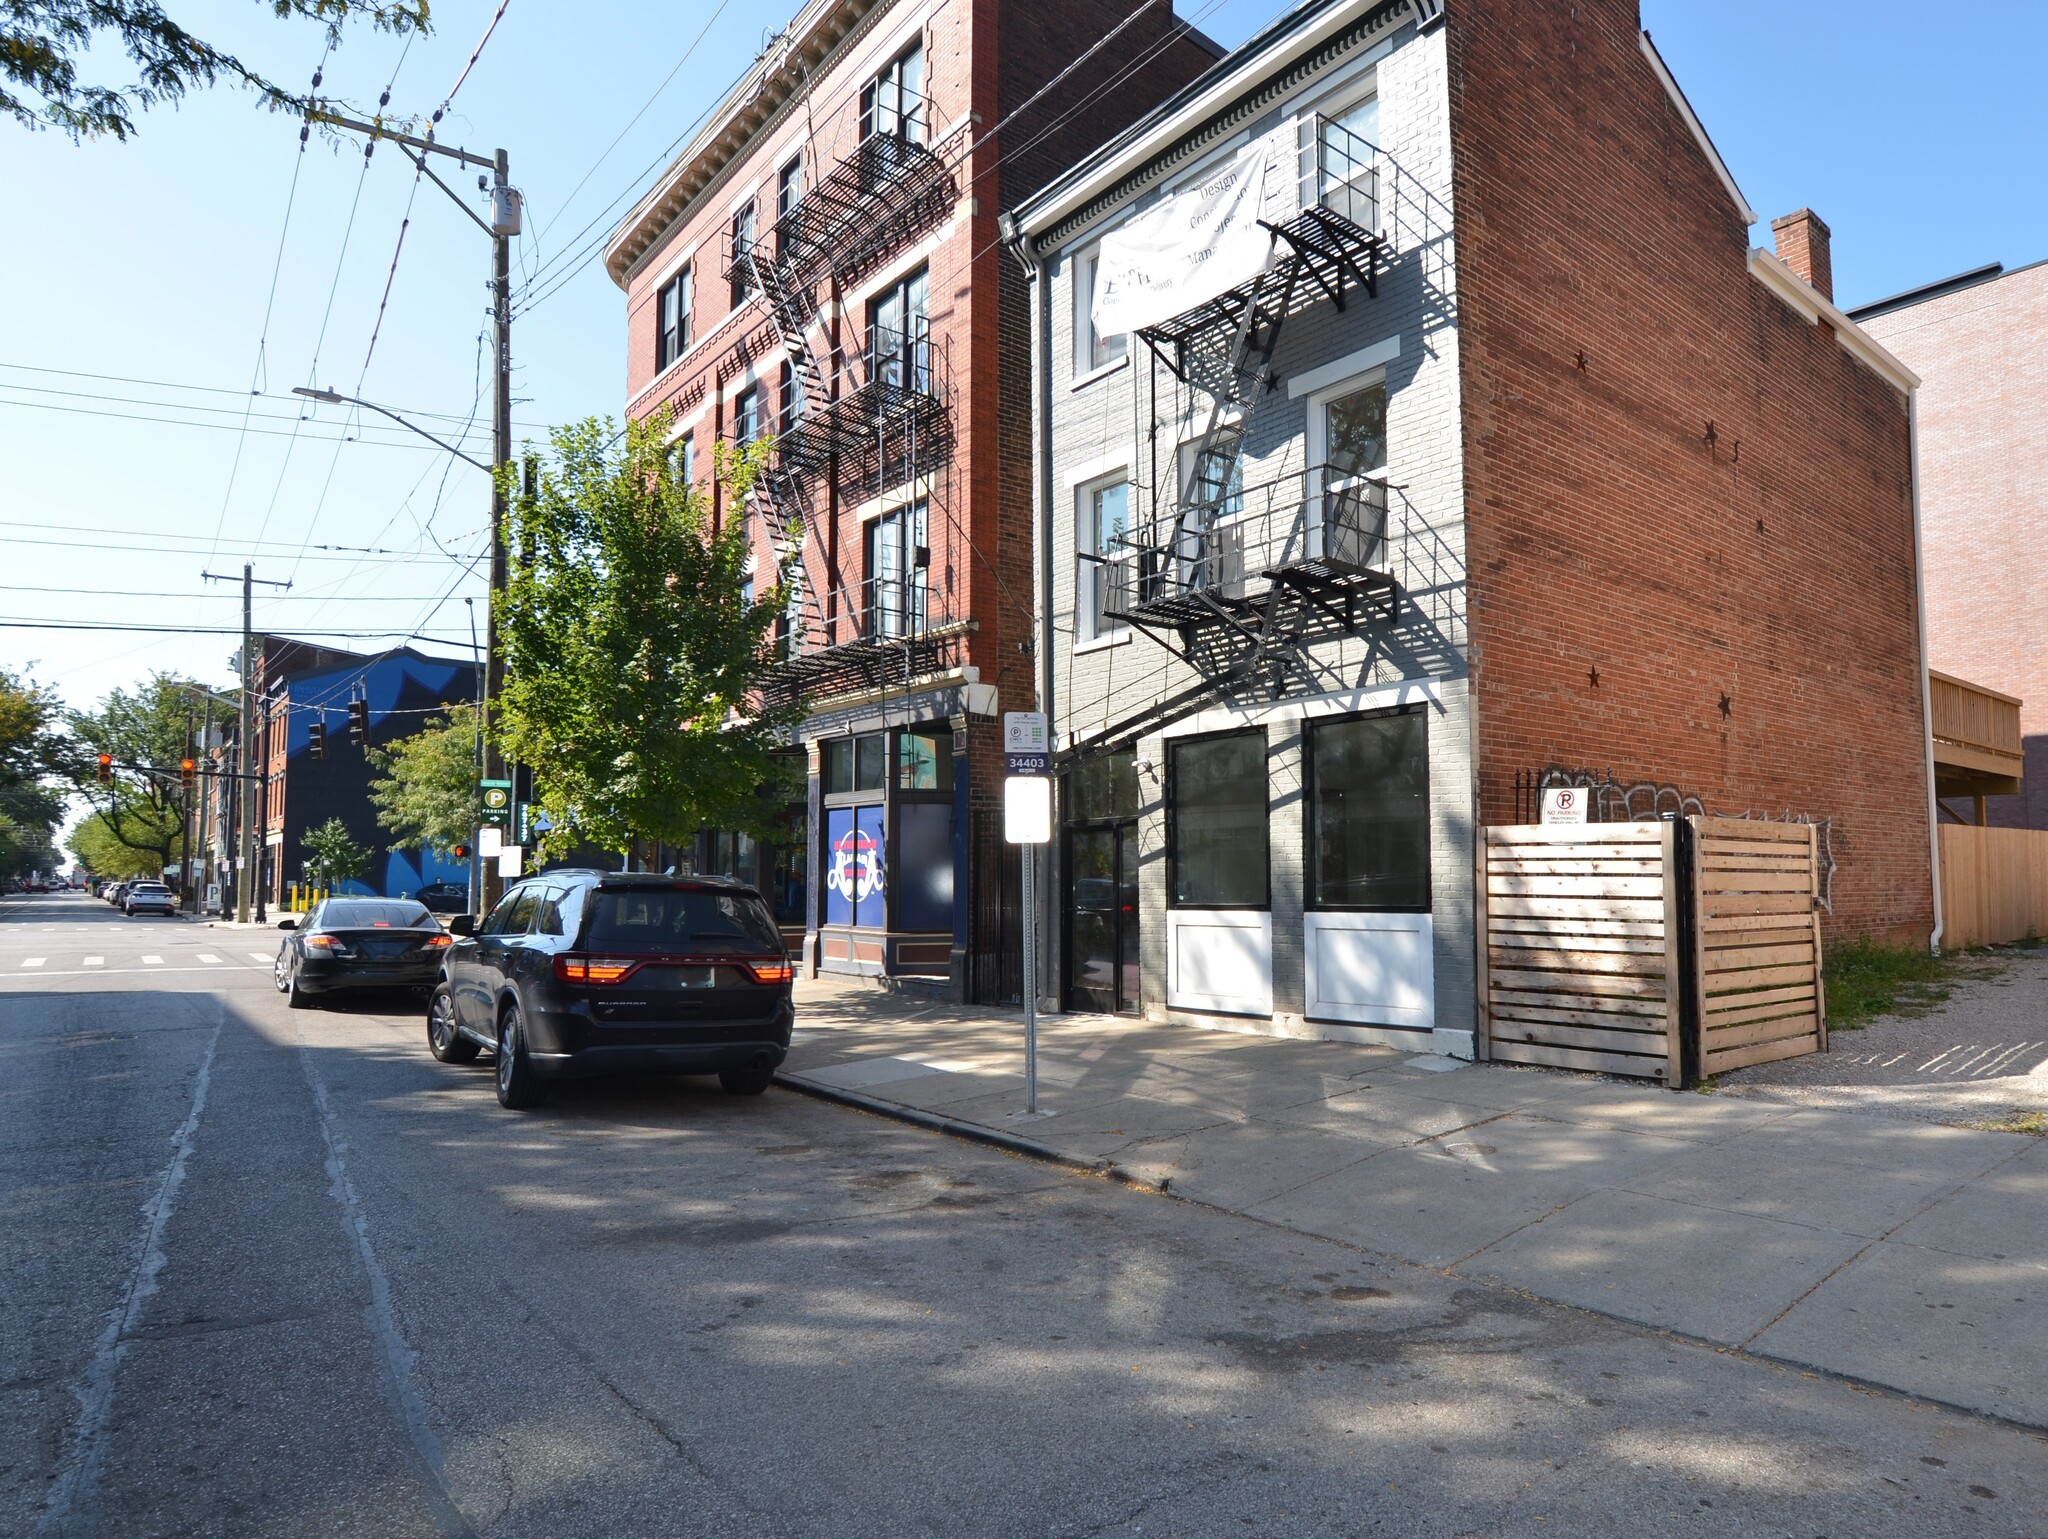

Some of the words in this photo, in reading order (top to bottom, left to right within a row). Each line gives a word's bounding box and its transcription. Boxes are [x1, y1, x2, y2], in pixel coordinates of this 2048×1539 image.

[1200, 173, 1238, 200] Design
[1009, 758, 1044, 768] 34403
[490, 792, 503, 805] P
[210, 886, 218, 899] P
